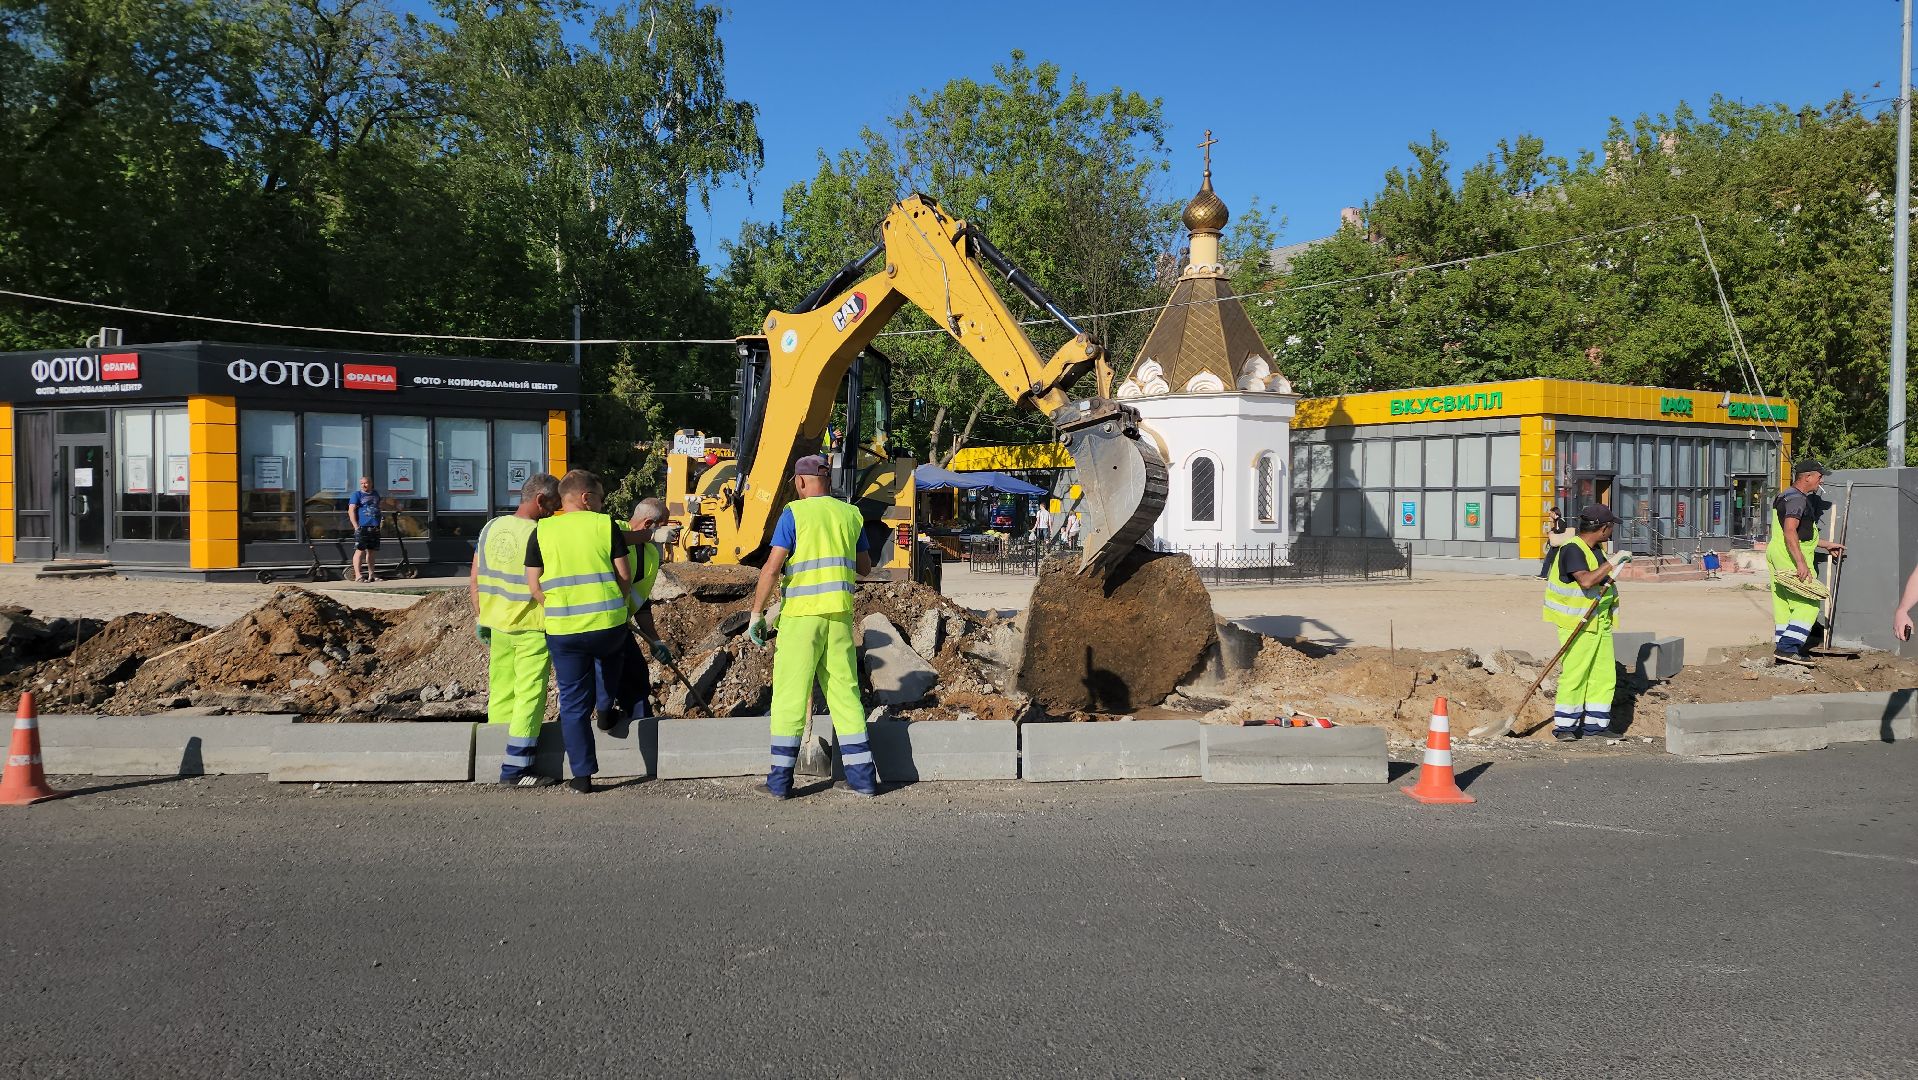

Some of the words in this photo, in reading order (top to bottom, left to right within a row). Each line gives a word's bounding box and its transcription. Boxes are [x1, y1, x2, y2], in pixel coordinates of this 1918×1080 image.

[832, 293, 861, 332] CAT
[31, 356, 94, 383] ФОТО
[103, 362, 137, 372] ФРАГМА
[227, 359, 330, 387] ФОТО
[346, 372, 394, 383] ФРАГМА
[413, 376, 442, 385] ФОТО
[447, 378, 530, 389] КОПИРОВАЛЬНЫЙ
[531, 382, 558, 391] ЦЕНТР
[36, 386, 56, 395] ФОТО
[58, 382, 120, 394] КОПИРОВАЛЬНЫЙ
[121, 383, 143, 392] ЦЕНТР
[1390, 391, 1503, 416] ВКУСВИЛЛ
